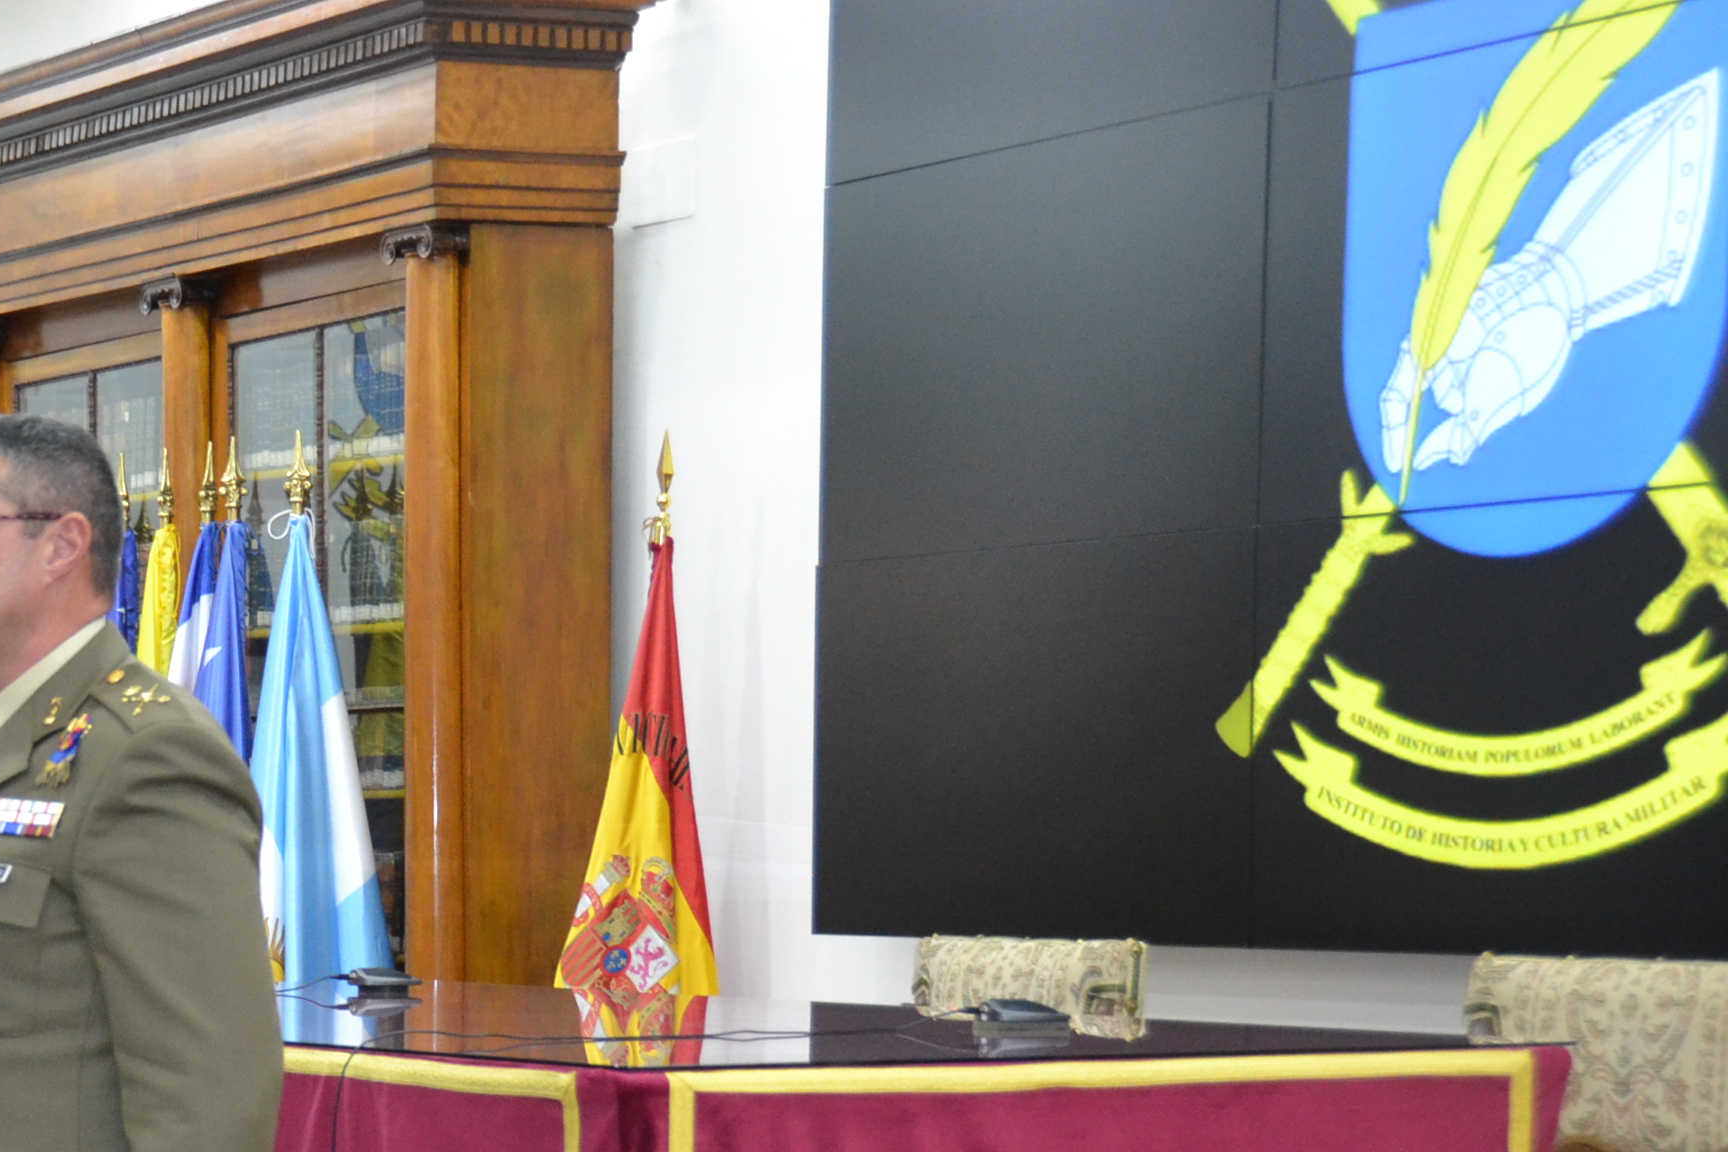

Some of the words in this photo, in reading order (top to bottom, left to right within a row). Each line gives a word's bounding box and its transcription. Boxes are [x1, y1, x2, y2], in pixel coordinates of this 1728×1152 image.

[1347, 711, 1391, 740] ARMIS
[1395, 732, 1479, 764] HISTORIAM
[1483, 737, 1584, 764] POPULORUM
[1588, 691, 1676, 744] LABORANT
[1317, 785, 1403, 836] INSTITUTO
[1405, 823, 1428, 843] DE
[1430, 831, 1516, 854] HISTORIA
[1516, 837, 1529, 852] Y
[1532, 817, 1624, 852] CULTURA
[1624, 775, 1707, 823] MILITAR
